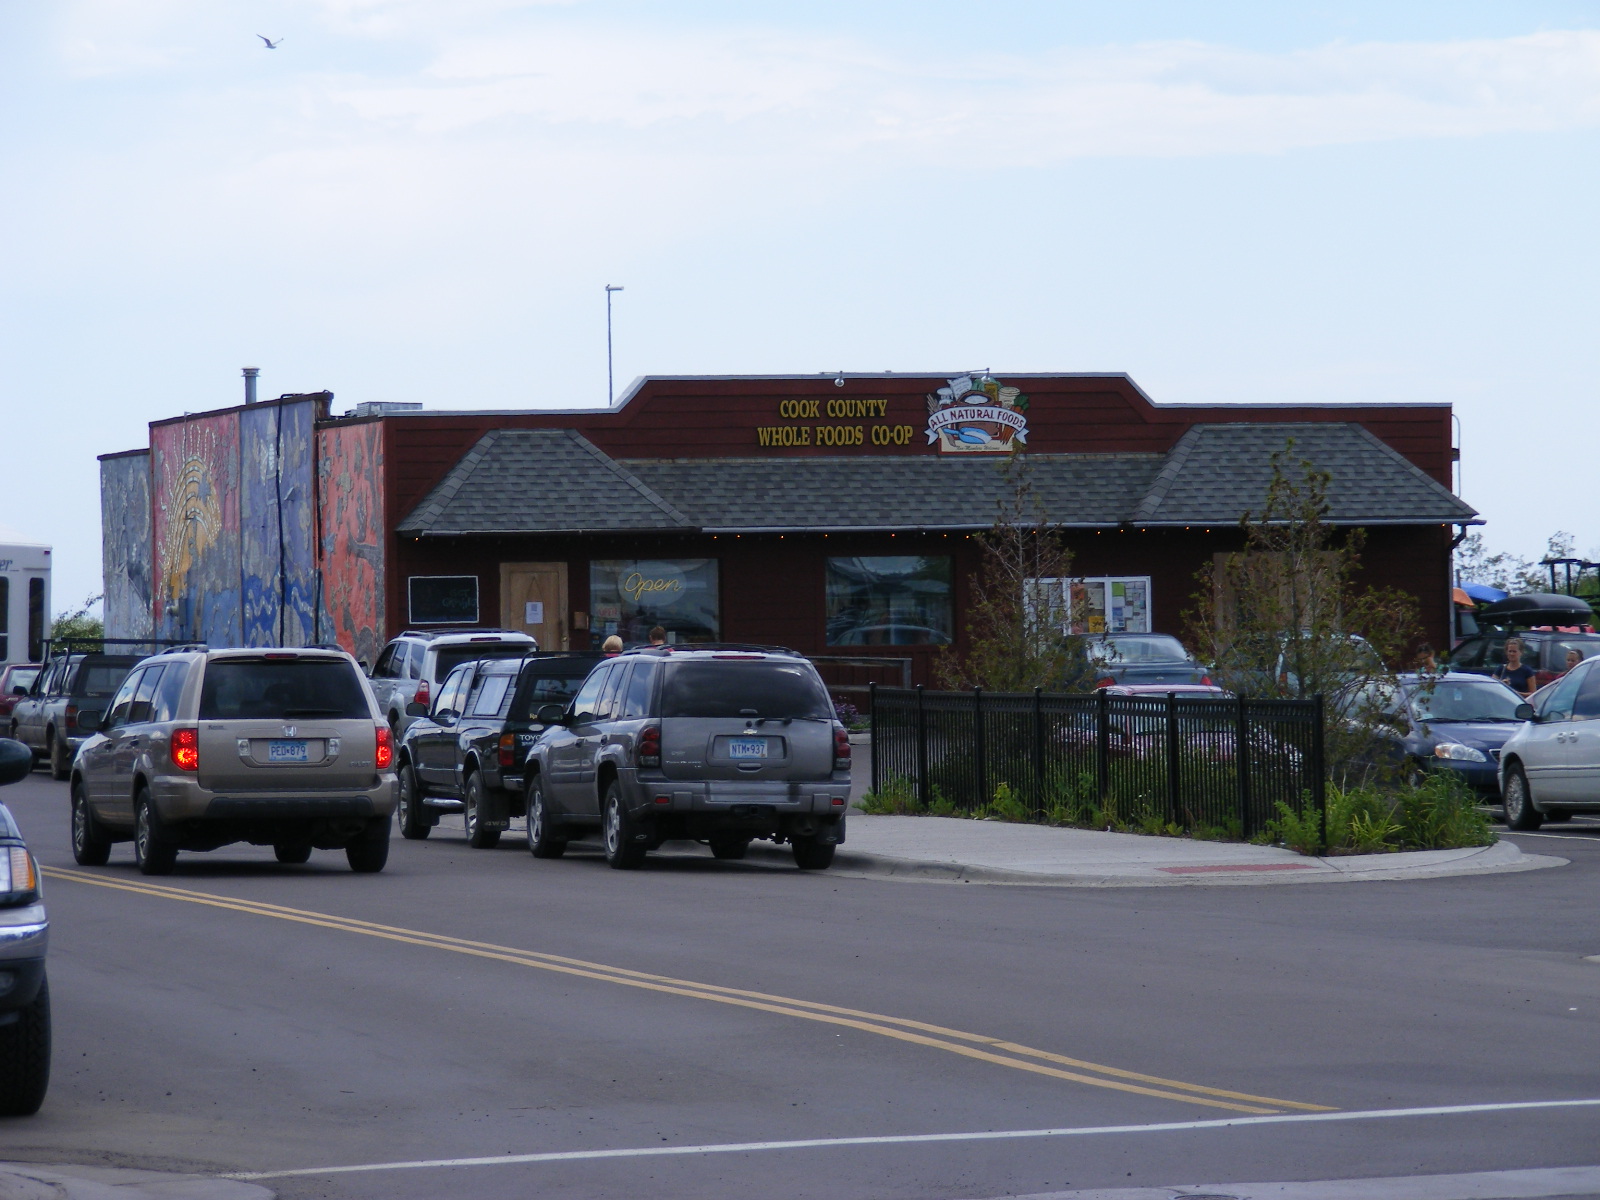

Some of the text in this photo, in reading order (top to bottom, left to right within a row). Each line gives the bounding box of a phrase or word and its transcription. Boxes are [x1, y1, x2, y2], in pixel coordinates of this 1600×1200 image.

[780, 400, 888, 418] COOK COUNTY
[930, 408, 1025, 429] ALL NATURAL FOODS
[757, 425, 914, 446] WHOLE FOODS CO-OP
[624, 572, 682, 600] Open
